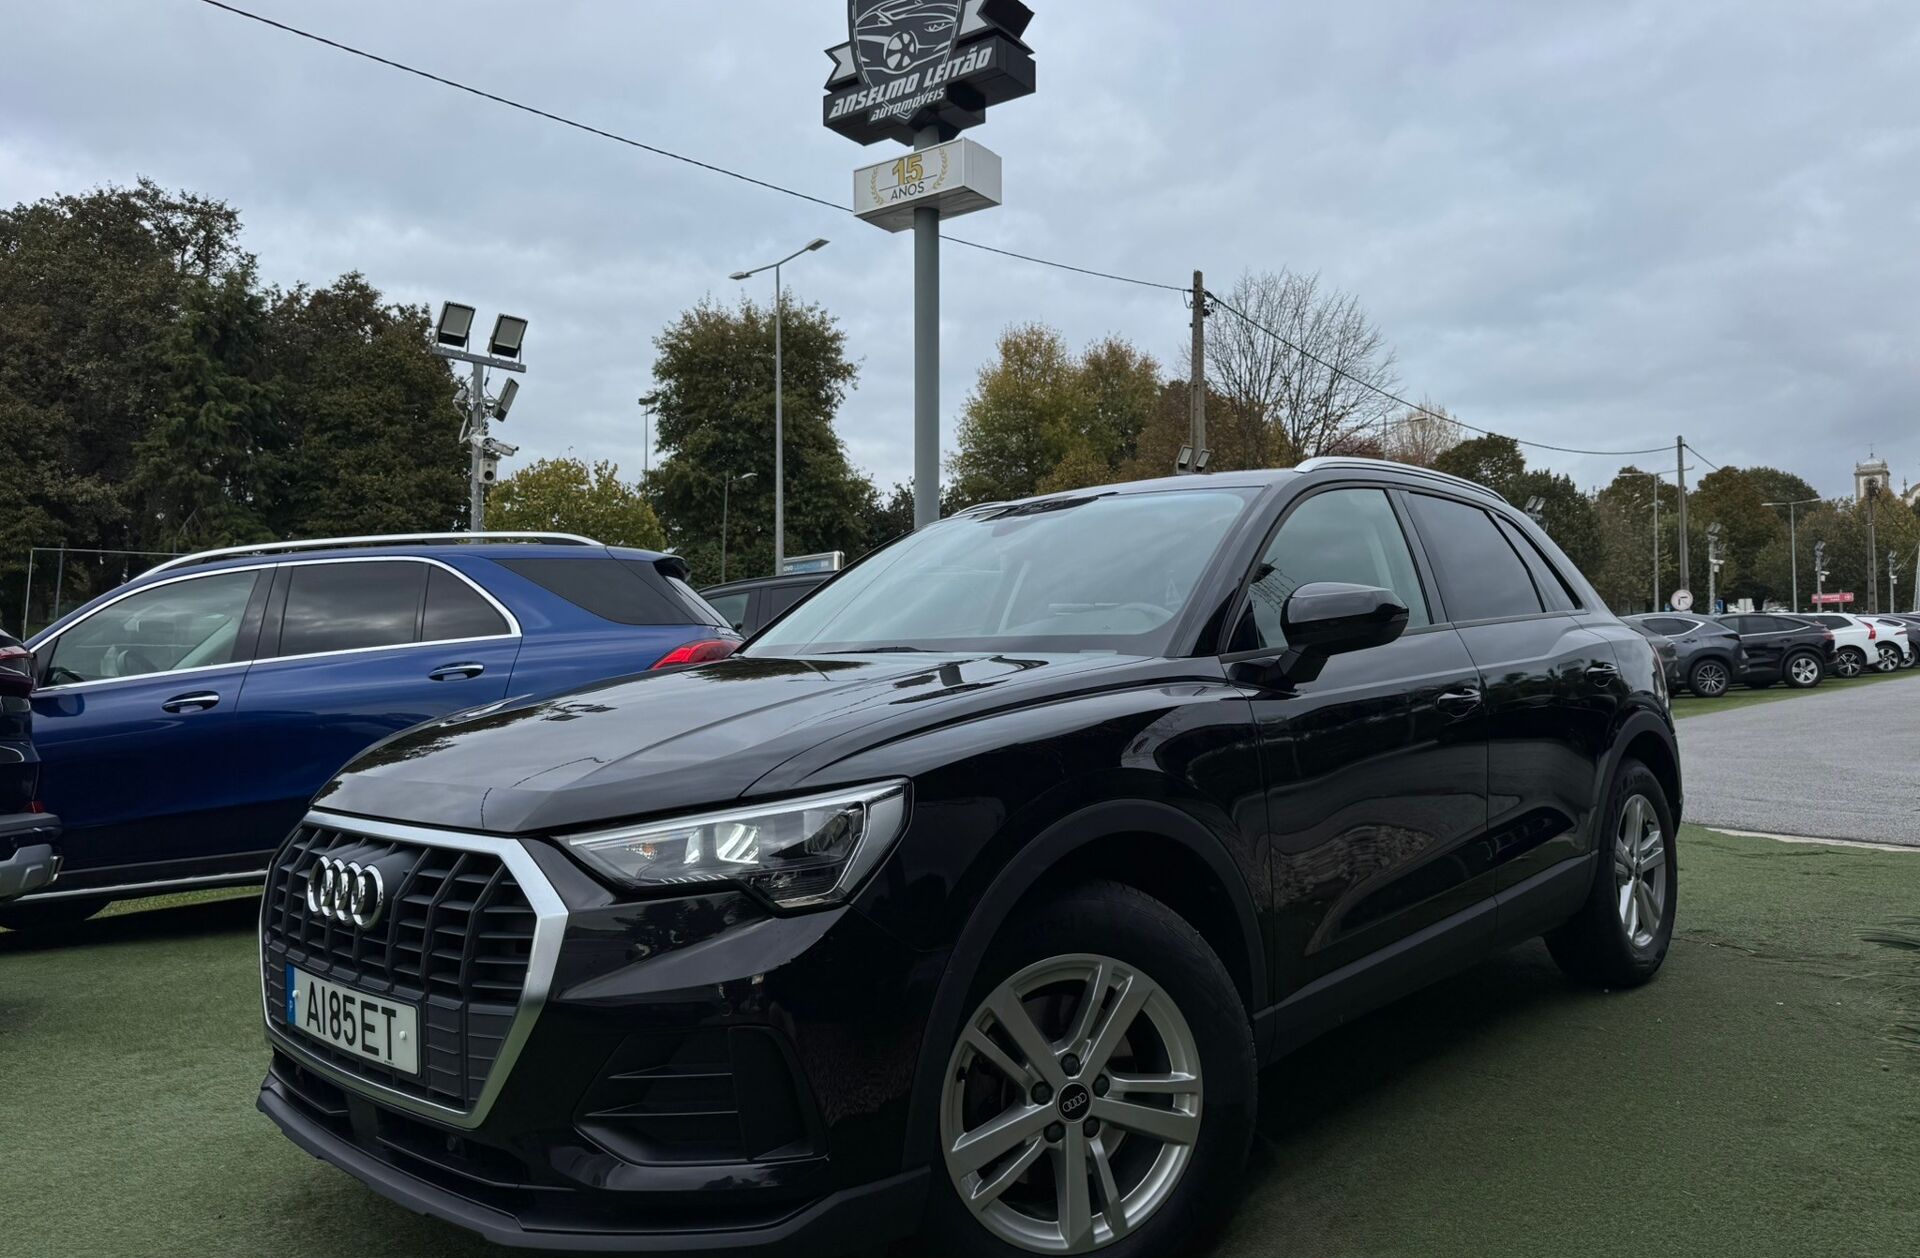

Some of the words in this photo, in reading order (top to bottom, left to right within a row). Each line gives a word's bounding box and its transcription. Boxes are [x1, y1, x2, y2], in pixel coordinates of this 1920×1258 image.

[828, 73, 920, 119] ANSELMO
[923, 46, 993, 88] LEITÃO
[870, 87, 945, 122] AUTOMÓVEIS
[892, 154, 923, 186] 15
[891, 181, 925, 201] ANOS
